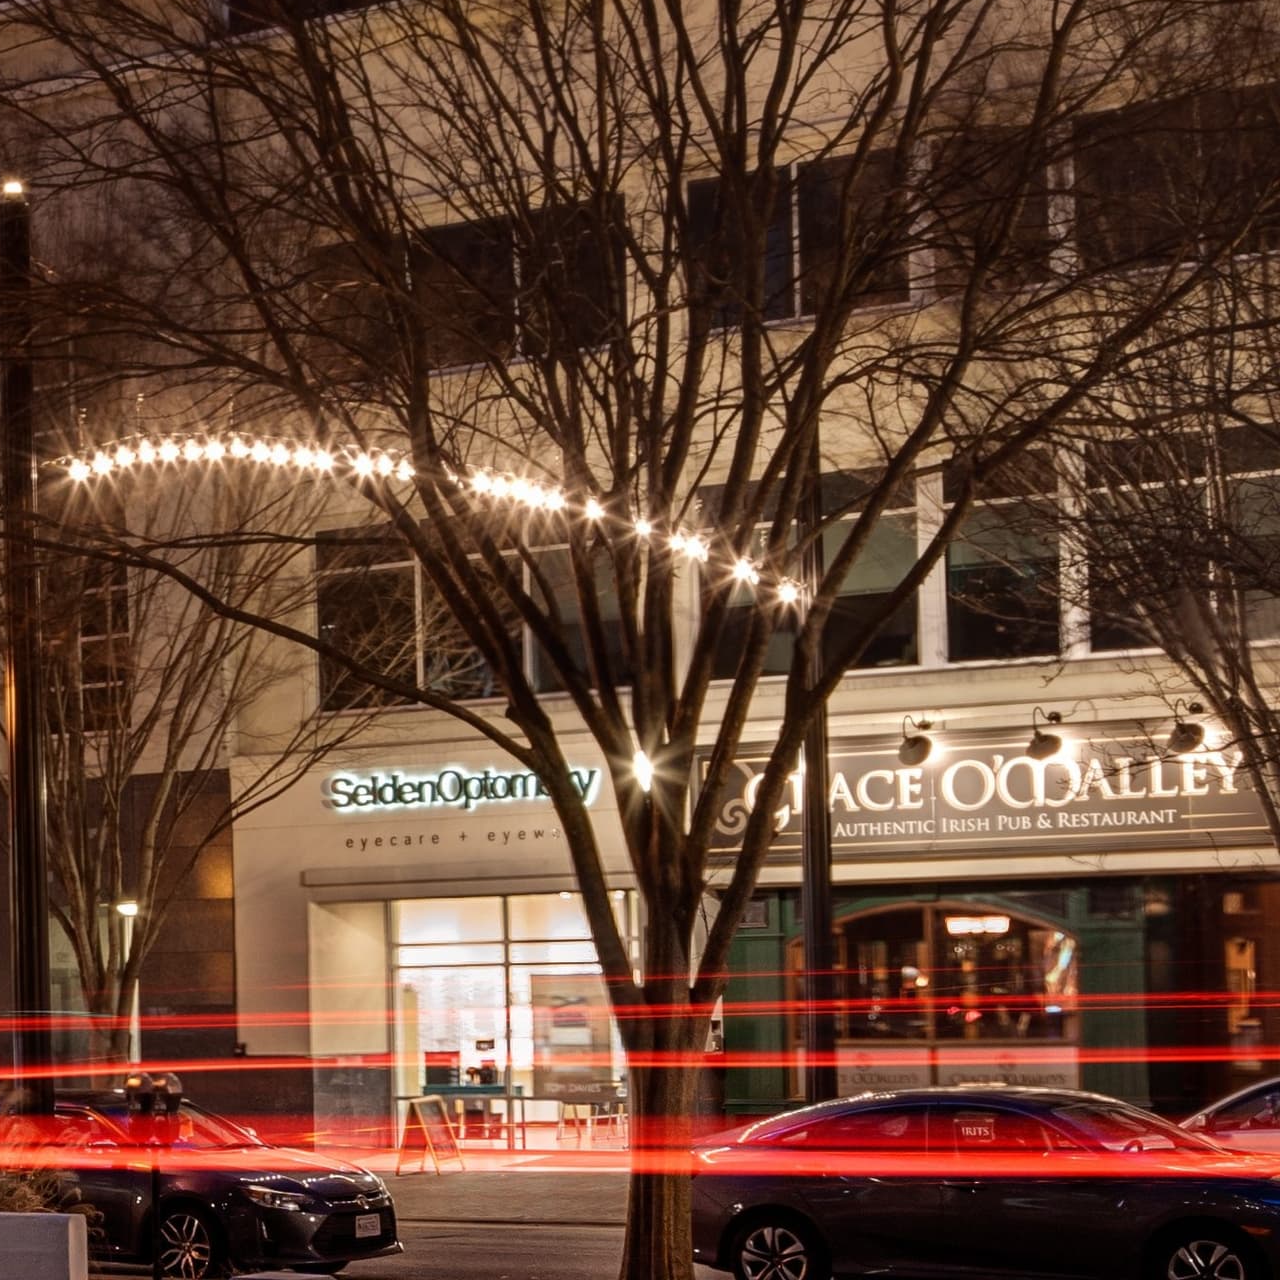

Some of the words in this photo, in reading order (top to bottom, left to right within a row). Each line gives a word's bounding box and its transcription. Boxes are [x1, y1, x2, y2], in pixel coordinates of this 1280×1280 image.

[331, 770, 597, 809] SeldenOptomy
[941, 751, 1246, 810] O'MALLEY
[834, 819, 936, 838] AUTHENTIC
[942, 817, 990, 834] IRISH
[997, 814, 1032, 831] PUB
[1037, 812, 1052, 829] &
[1058, 809, 1177, 829] RESTAURANT
[345, 831, 441, 851] eyecare
